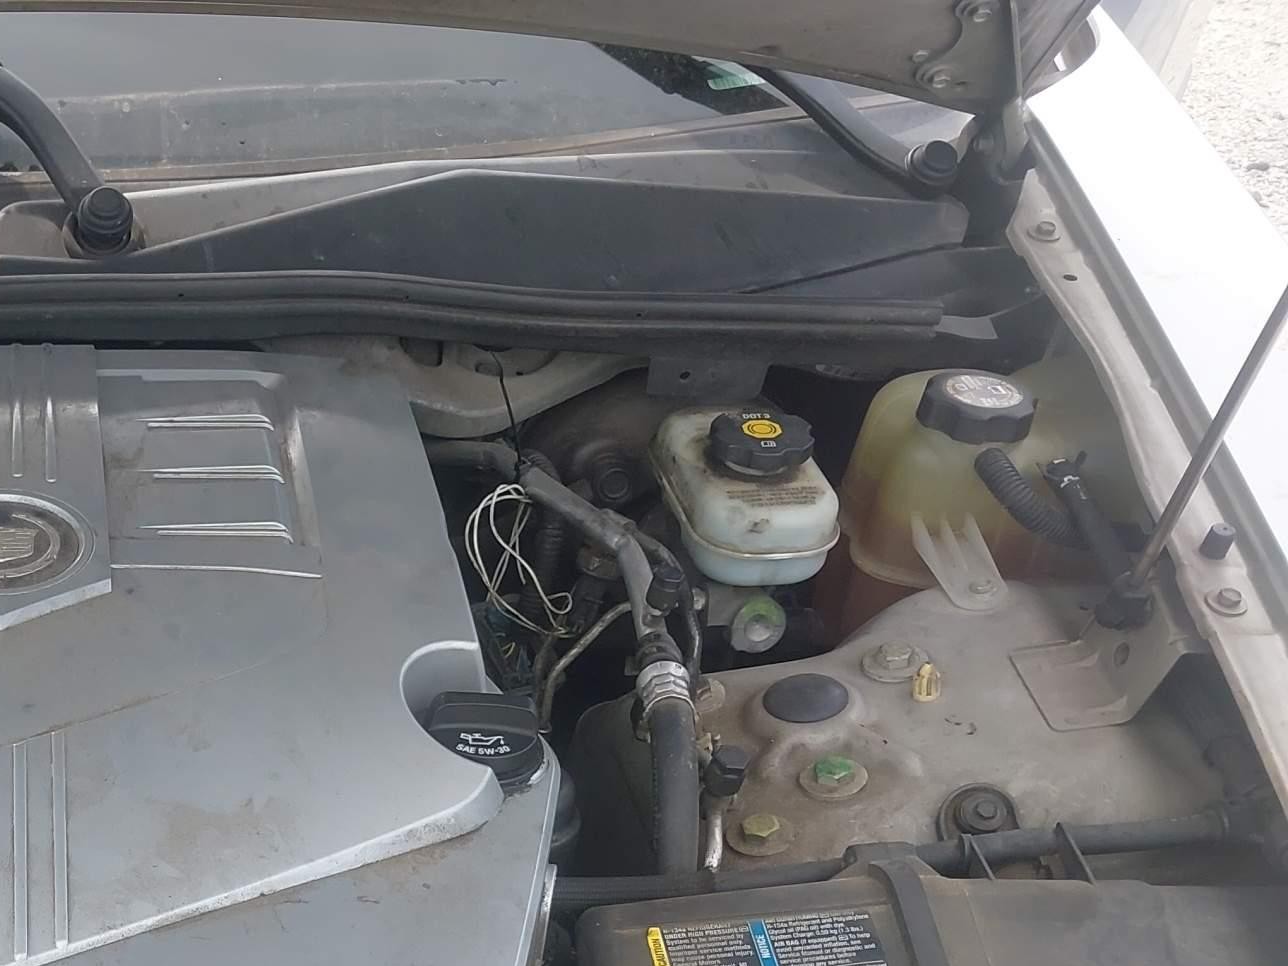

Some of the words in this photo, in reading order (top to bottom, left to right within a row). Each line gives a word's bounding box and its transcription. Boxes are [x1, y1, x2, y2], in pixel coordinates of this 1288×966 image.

[455, 743, 475, 755] SAE
[478, 744, 511, 756] 5W-30
[654, 938, 668, 966] CAUTION
[755, 934, 772, 959] NOTICE
